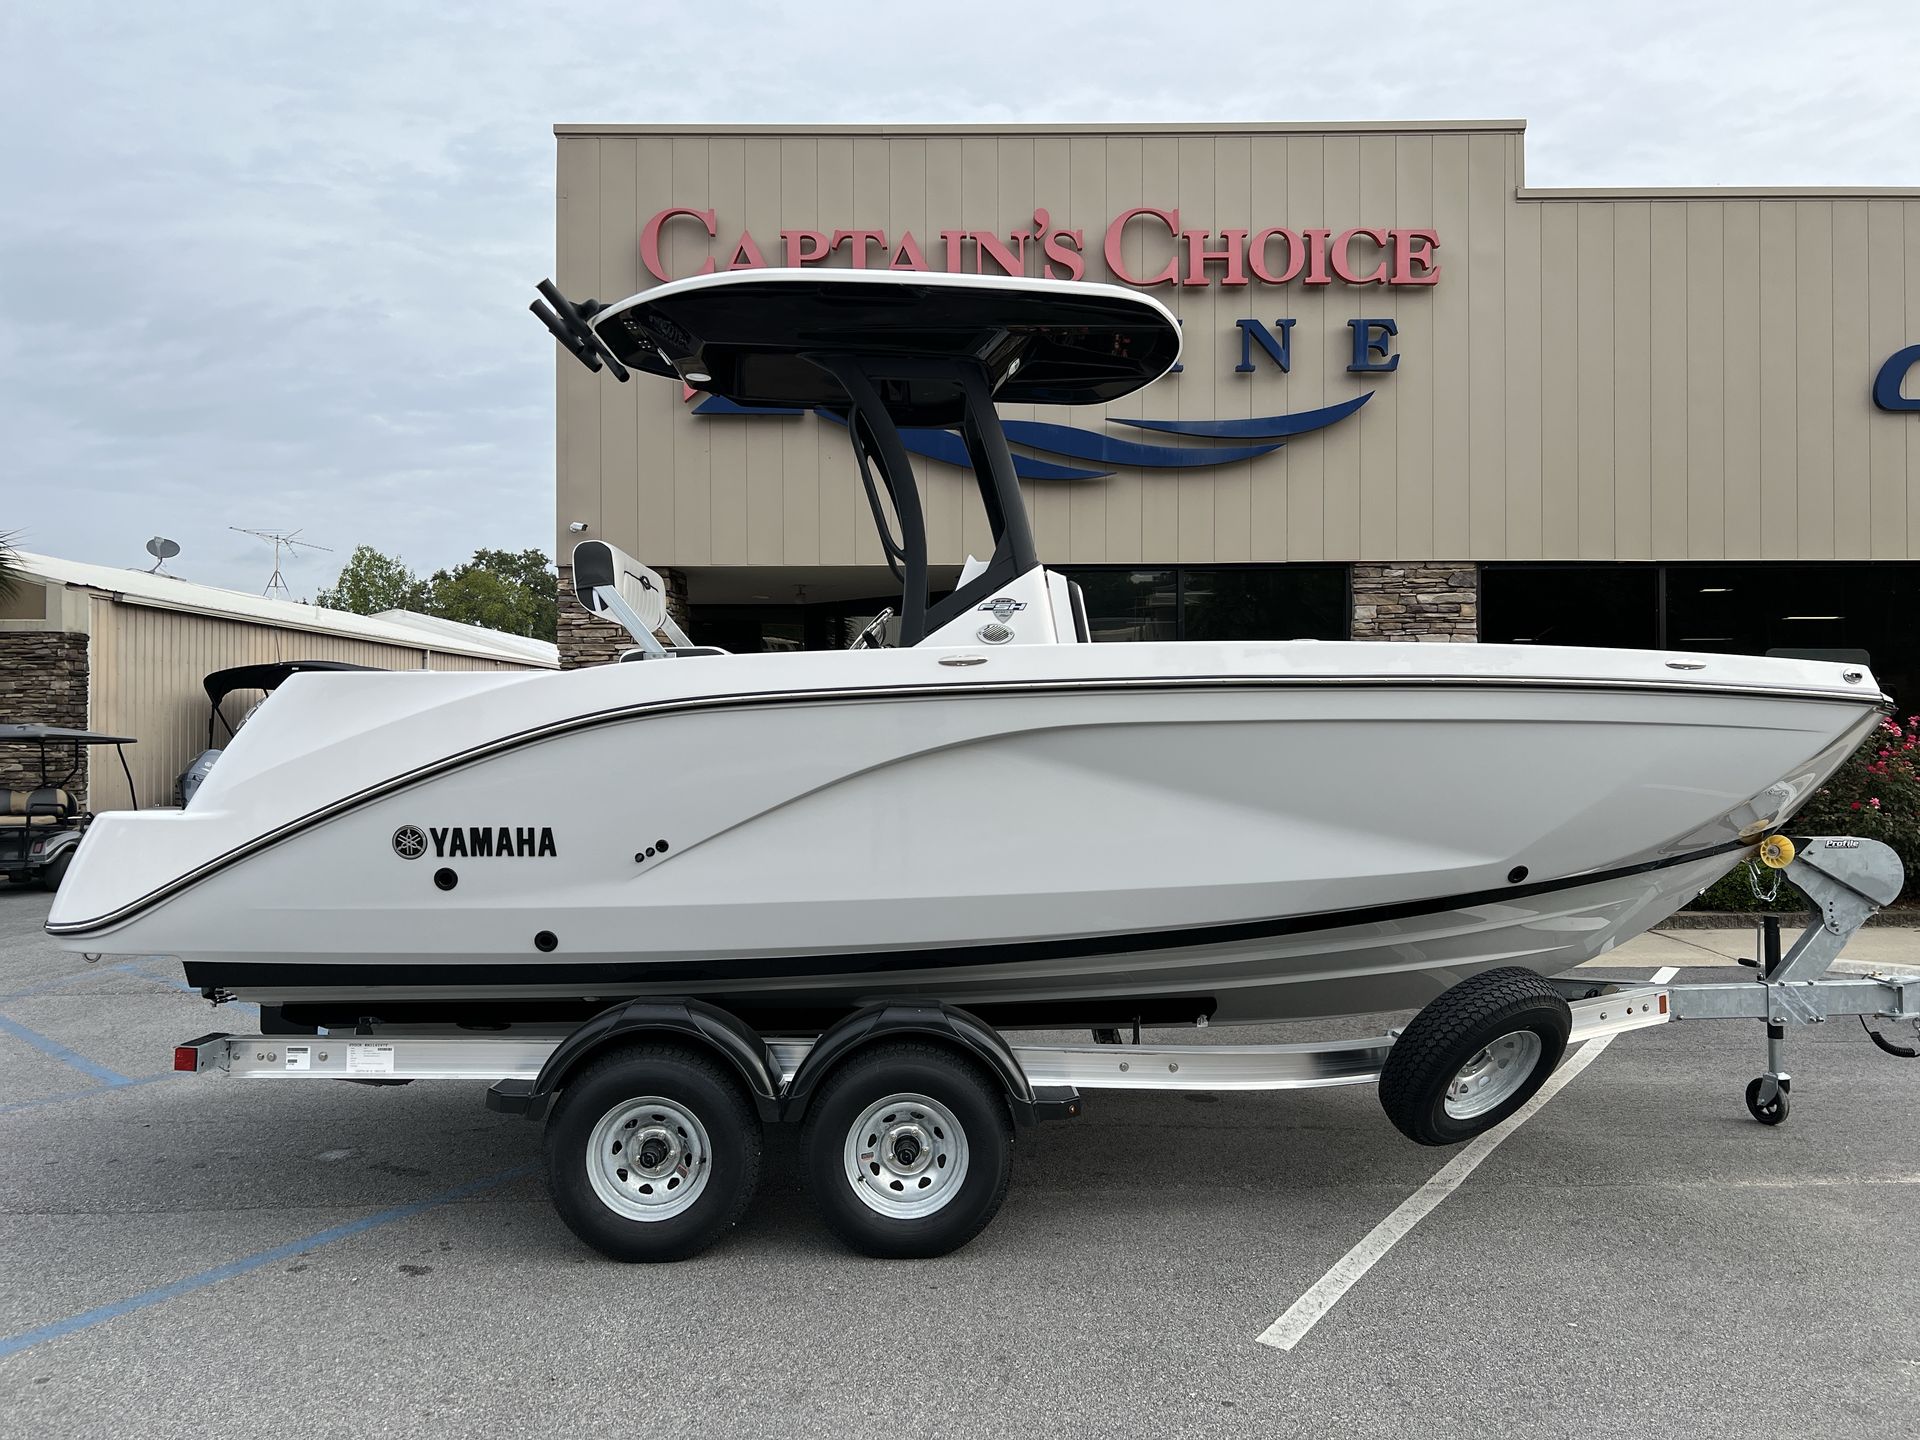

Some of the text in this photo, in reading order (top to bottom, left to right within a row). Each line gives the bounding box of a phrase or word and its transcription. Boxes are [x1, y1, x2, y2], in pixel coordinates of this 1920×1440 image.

[639, 207, 1441, 287] CAPTAIN'S CHOICE
[429, 827, 558, 858] YAMAHA
[1825, 839, 1860, 849] Profile
